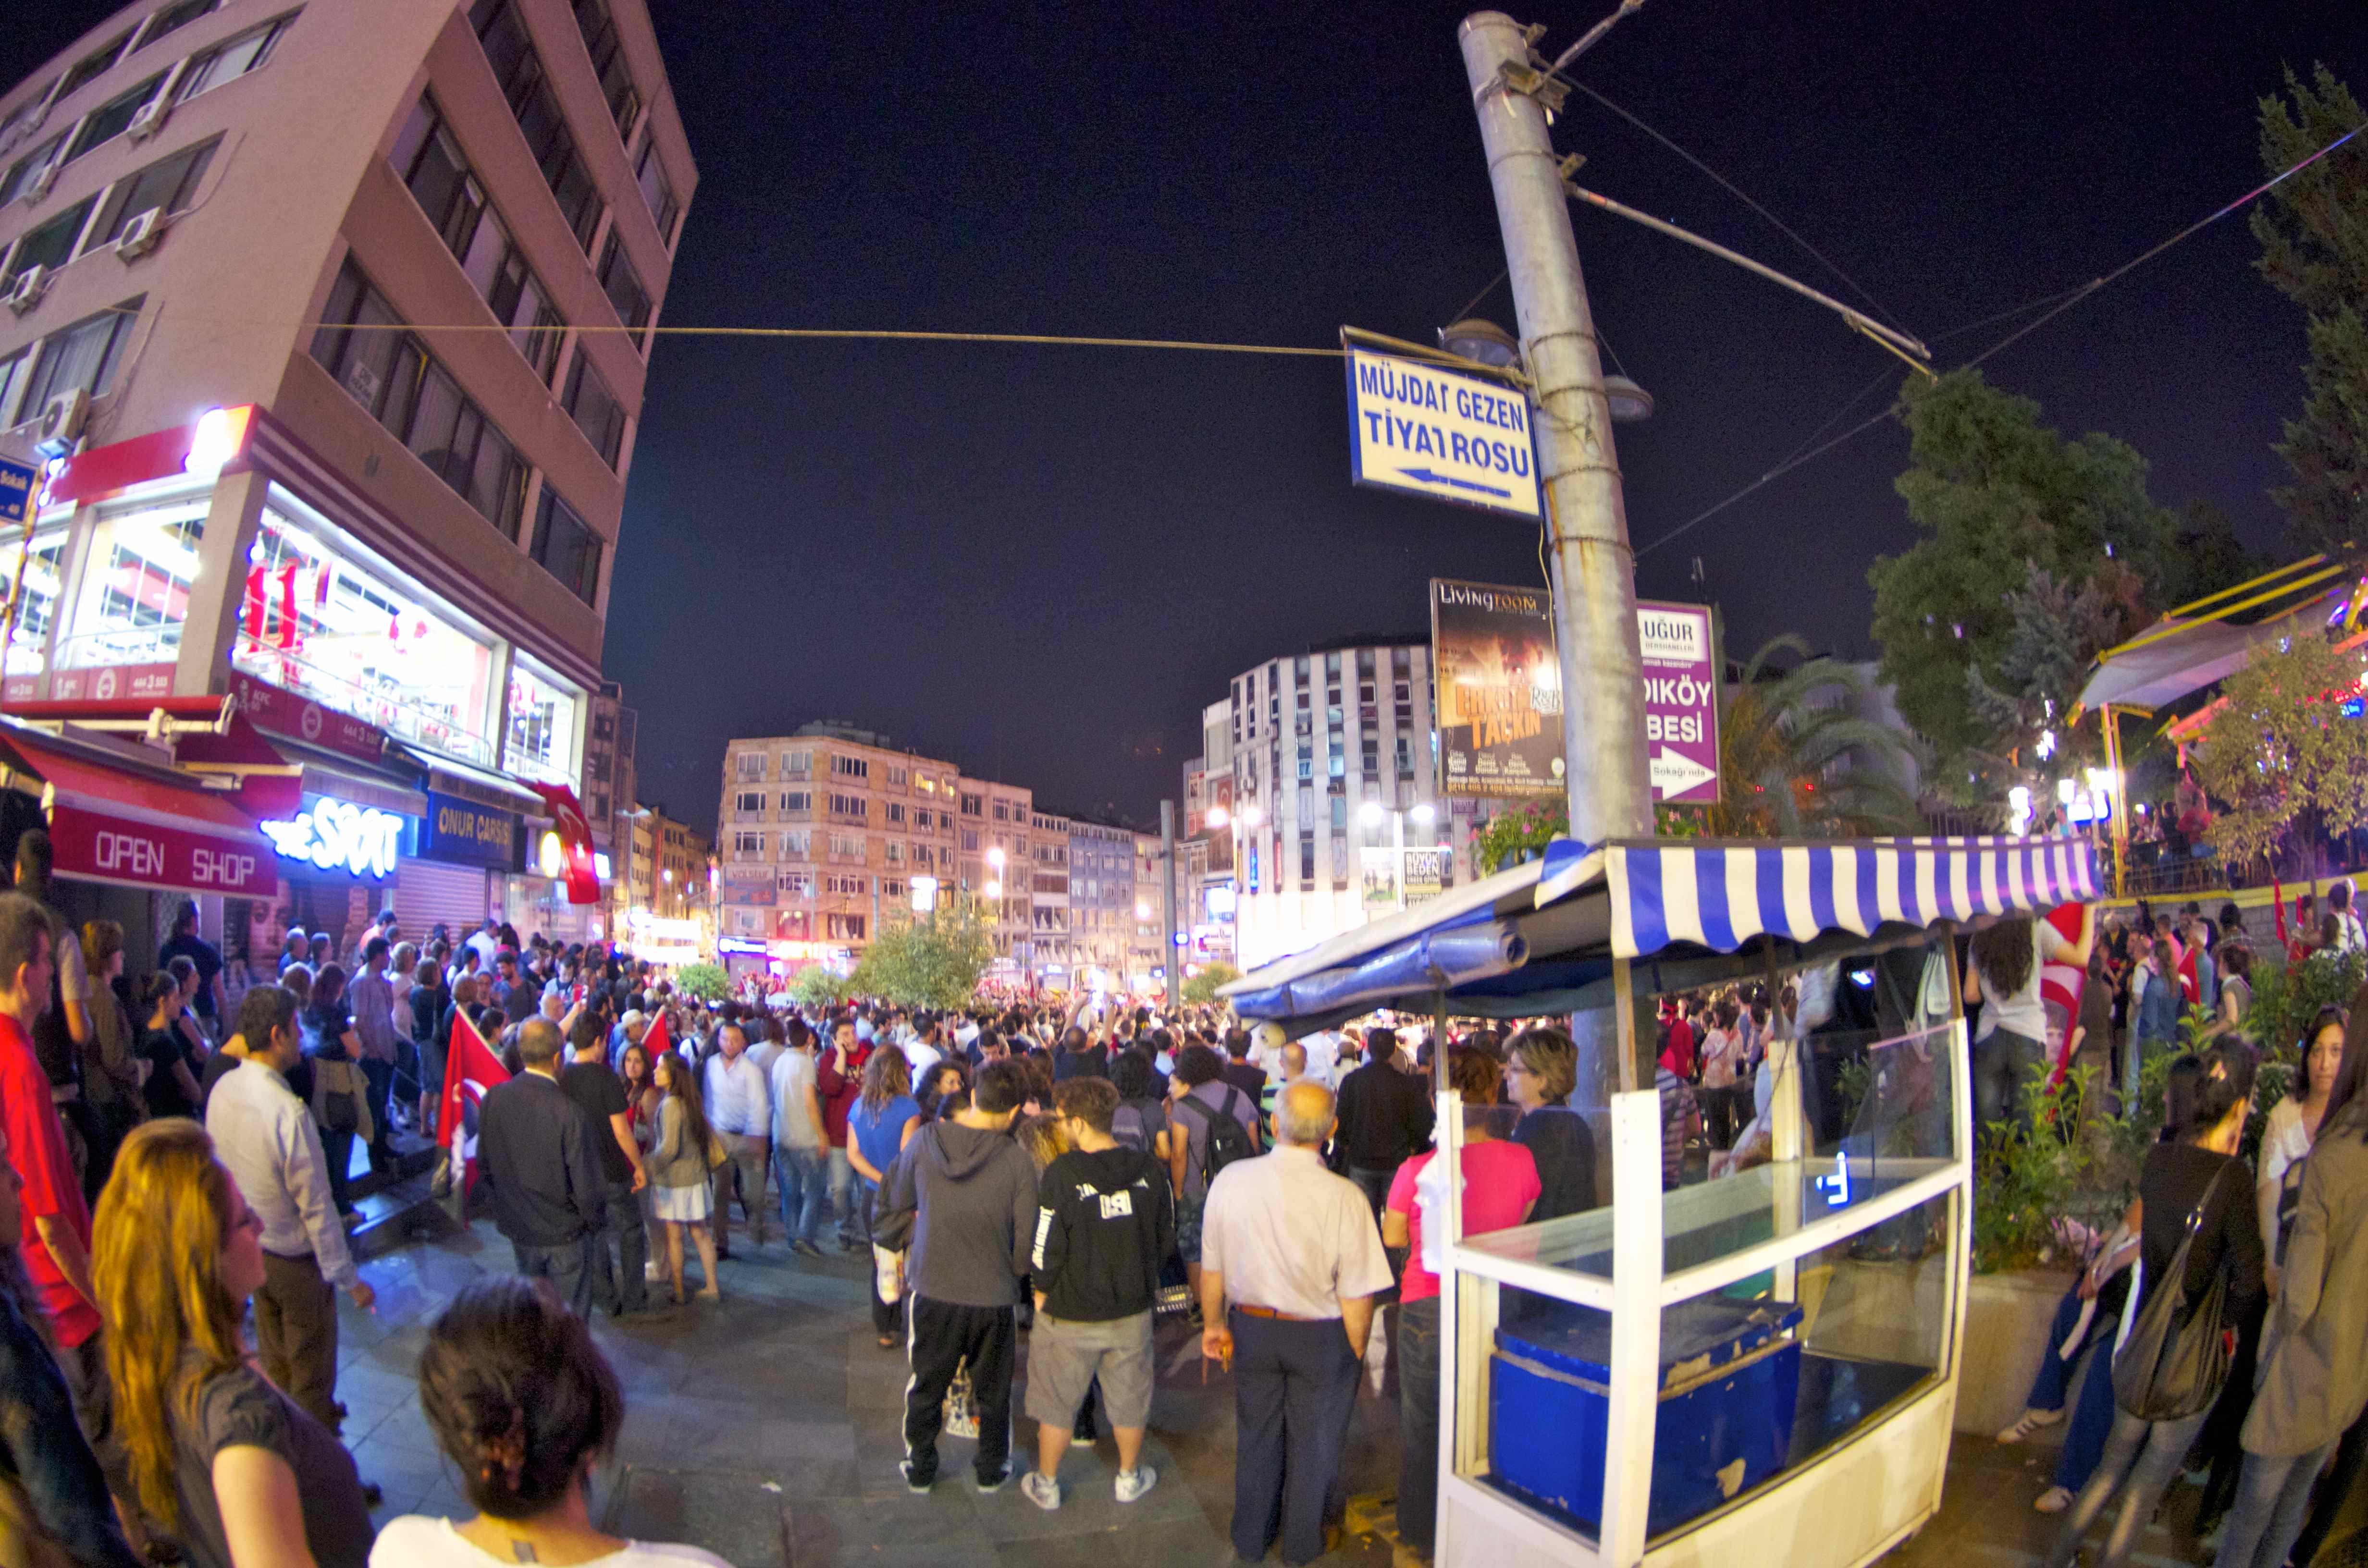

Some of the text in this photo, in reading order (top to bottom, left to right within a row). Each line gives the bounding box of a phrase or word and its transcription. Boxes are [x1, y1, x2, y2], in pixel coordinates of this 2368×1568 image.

[1359, 361, 1524, 432] MÜJDAT GEZEN
[1364, 408, 1529, 477] TİYATROSU
[1644, 615, 1692, 641] UĞUR
[1647, 711, 1703, 743] BESİ
[439, 806, 474, 838] ONUR
[97, 830, 255, 886] OPEN SHOP
[1406, 865, 1439, 875] BEDEN
